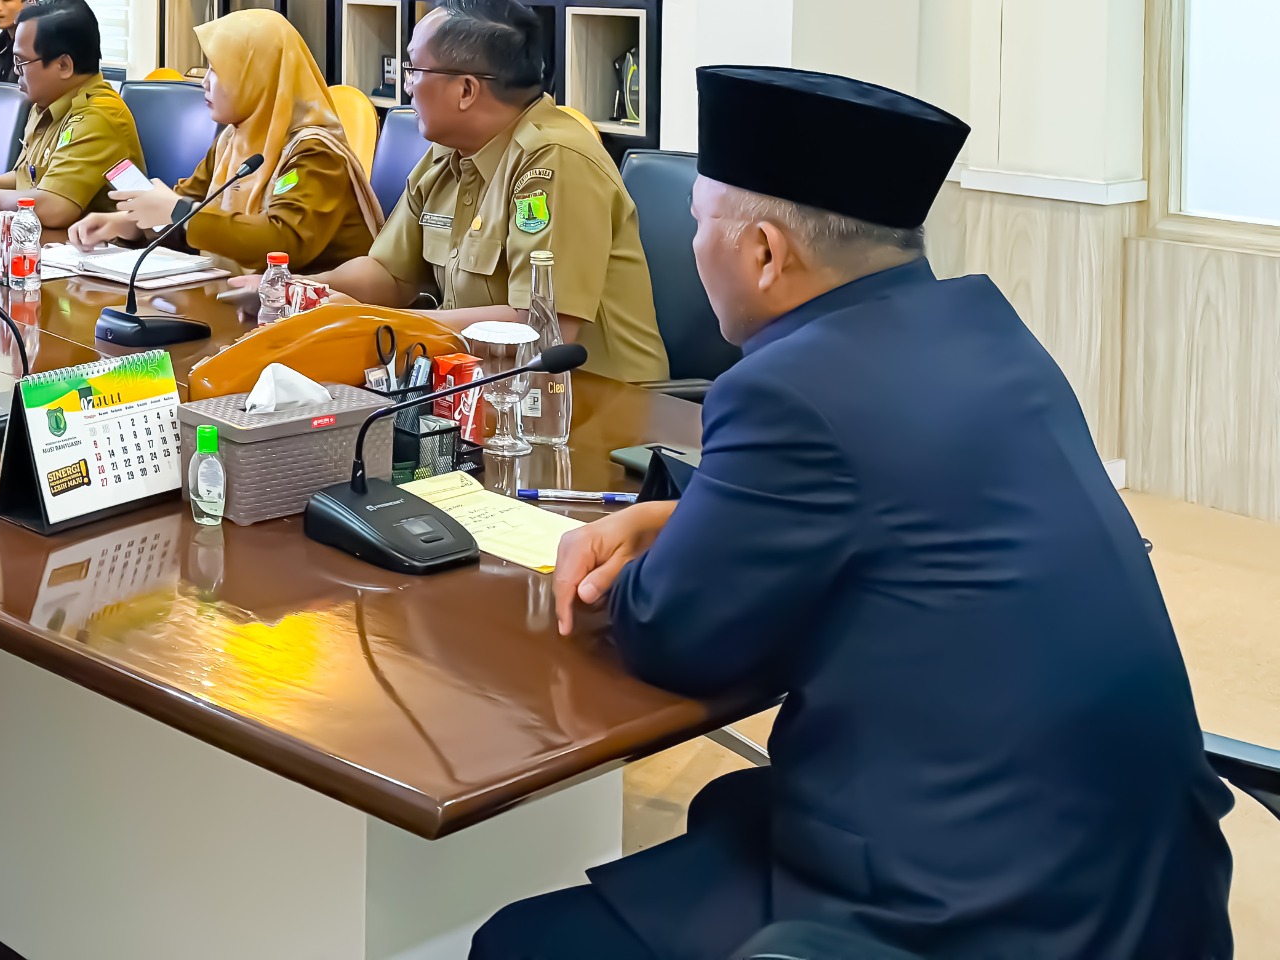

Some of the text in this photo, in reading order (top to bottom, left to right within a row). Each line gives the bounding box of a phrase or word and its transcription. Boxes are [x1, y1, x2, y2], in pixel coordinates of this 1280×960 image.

[548, 381, 565, 394] Cleo
[96, 392, 121, 407] JULI
[117, 421, 122, 429] 1
[130, 418, 135, 426] 2
[143, 415, 148, 423] 3
[156, 412, 161, 420] 4
[169, 409, 174, 417] 5
[93, 421, 177, 448] 6 7 8 9 10 11 12
[95, 433, 180, 461] 13 14 15 16 17 18 19
[98, 465, 105, 474] 20
[111, 462, 118, 471] 21
[124, 458, 131, 468] 22
[137, 455, 144, 464] 23
[150, 452, 158, 460] 24
[163, 448, 170, 458] 25
[48, 463, 80, 482] SINERGI
[101, 478, 108, 487] 27
[114, 474, 121, 483] 28
[127, 471, 134, 480] 29
[140, 468, 147, 477] 30
[153, 464, 160, 473] 31
